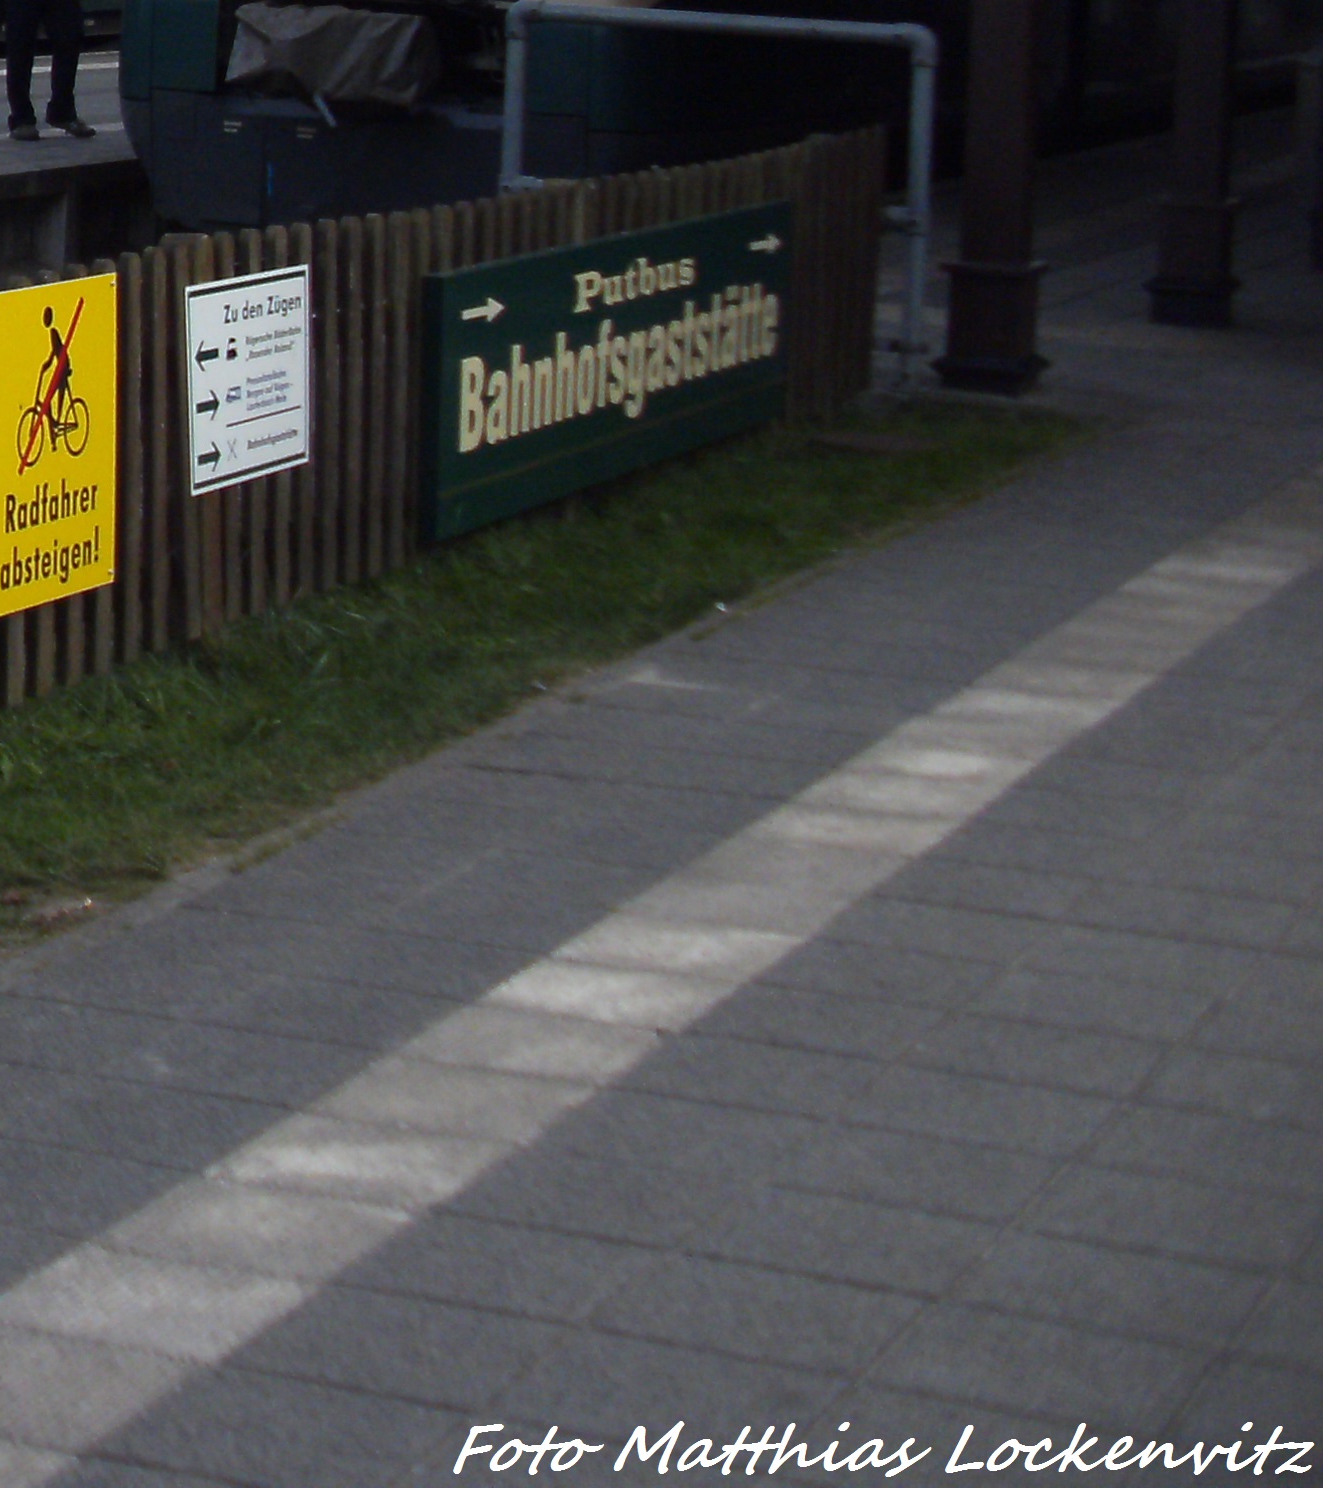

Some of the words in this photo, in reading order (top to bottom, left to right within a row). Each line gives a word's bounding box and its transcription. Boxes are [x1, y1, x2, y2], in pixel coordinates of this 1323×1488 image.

[223, 304, 239, 324] Zu
[241, 300, 263, 320] den
[267, 295, 302, 317] Zügen
[573, 257, 695, 313] Putbus
[458, 283, 780, 453] Bahnhofsgaststätte
[4, 478, 98, 534] Radfahrer
[0, 524, 100, 591] absteigen!
